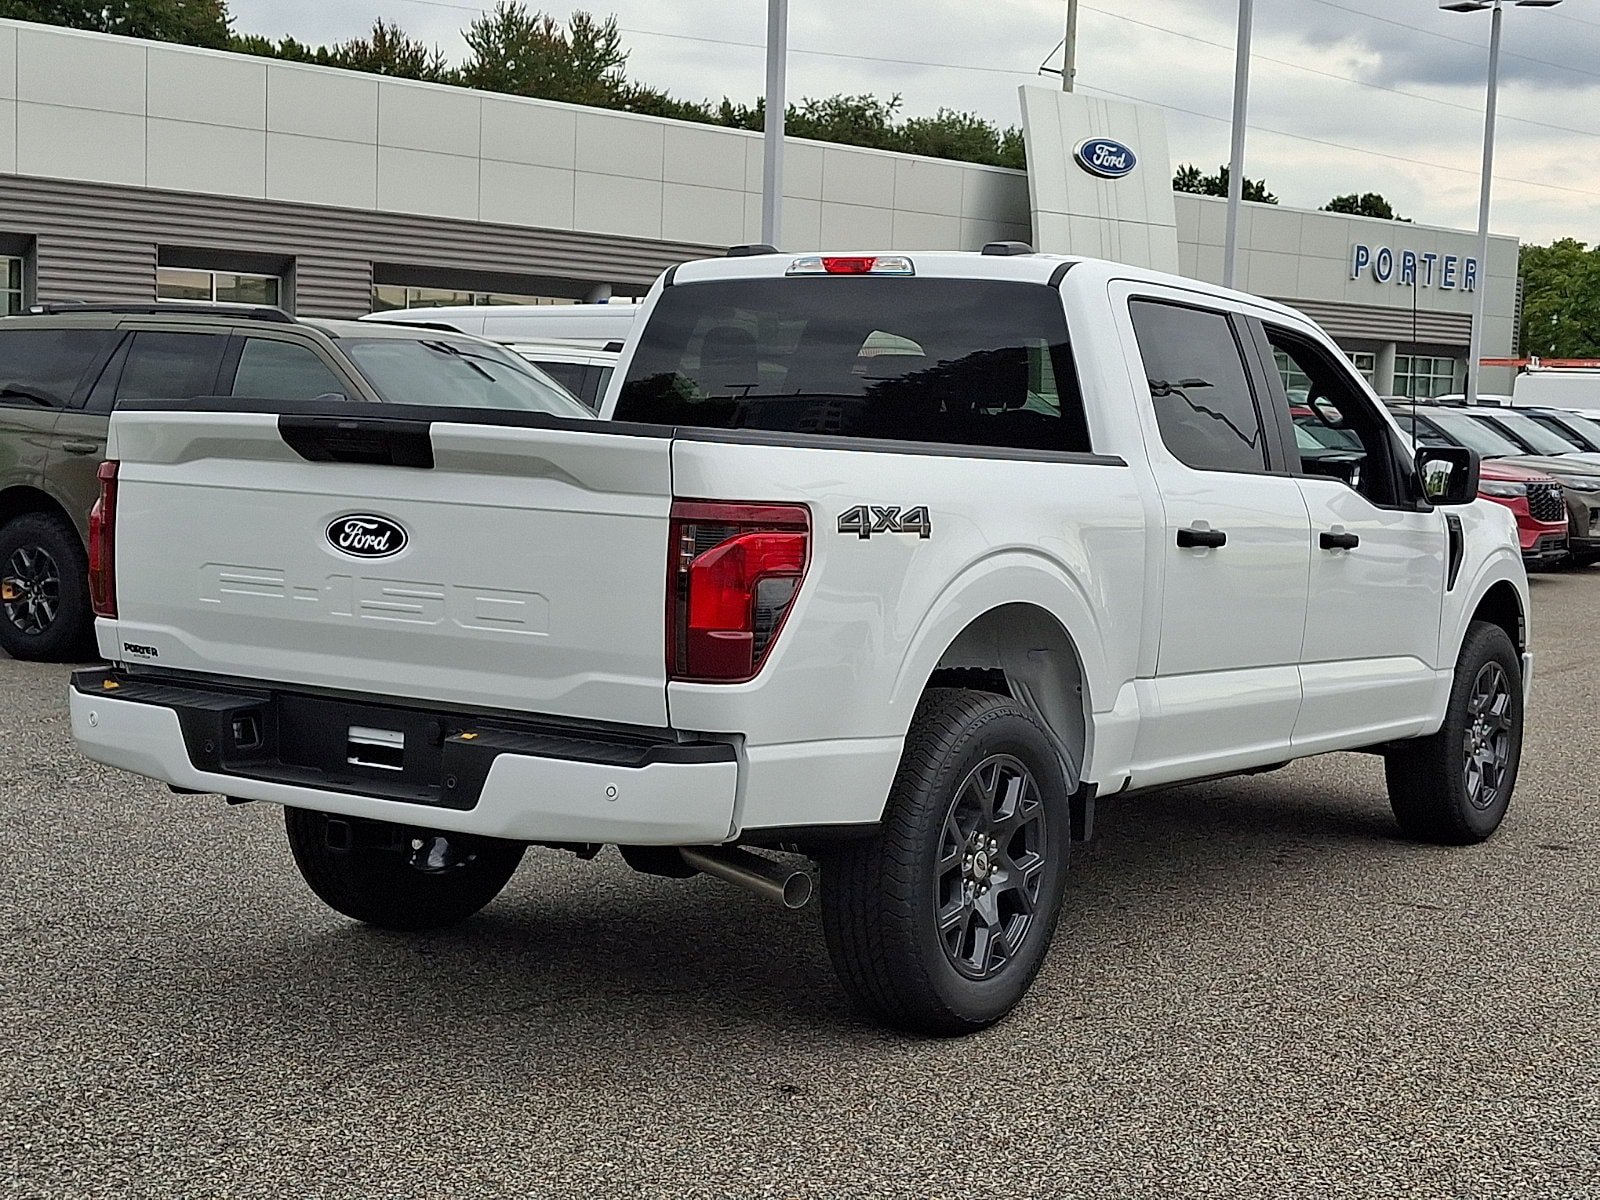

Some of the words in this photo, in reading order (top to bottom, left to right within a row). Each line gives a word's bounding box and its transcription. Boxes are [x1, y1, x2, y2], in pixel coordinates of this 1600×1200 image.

[1093, 144, 1126, 169] Ford
[1352, 243, 1477, 292] PORTER
[340, 520, 392, 551] Ford
[200, 562, 550, 637] F-150
[123, 642, 159, 657] PORTER
